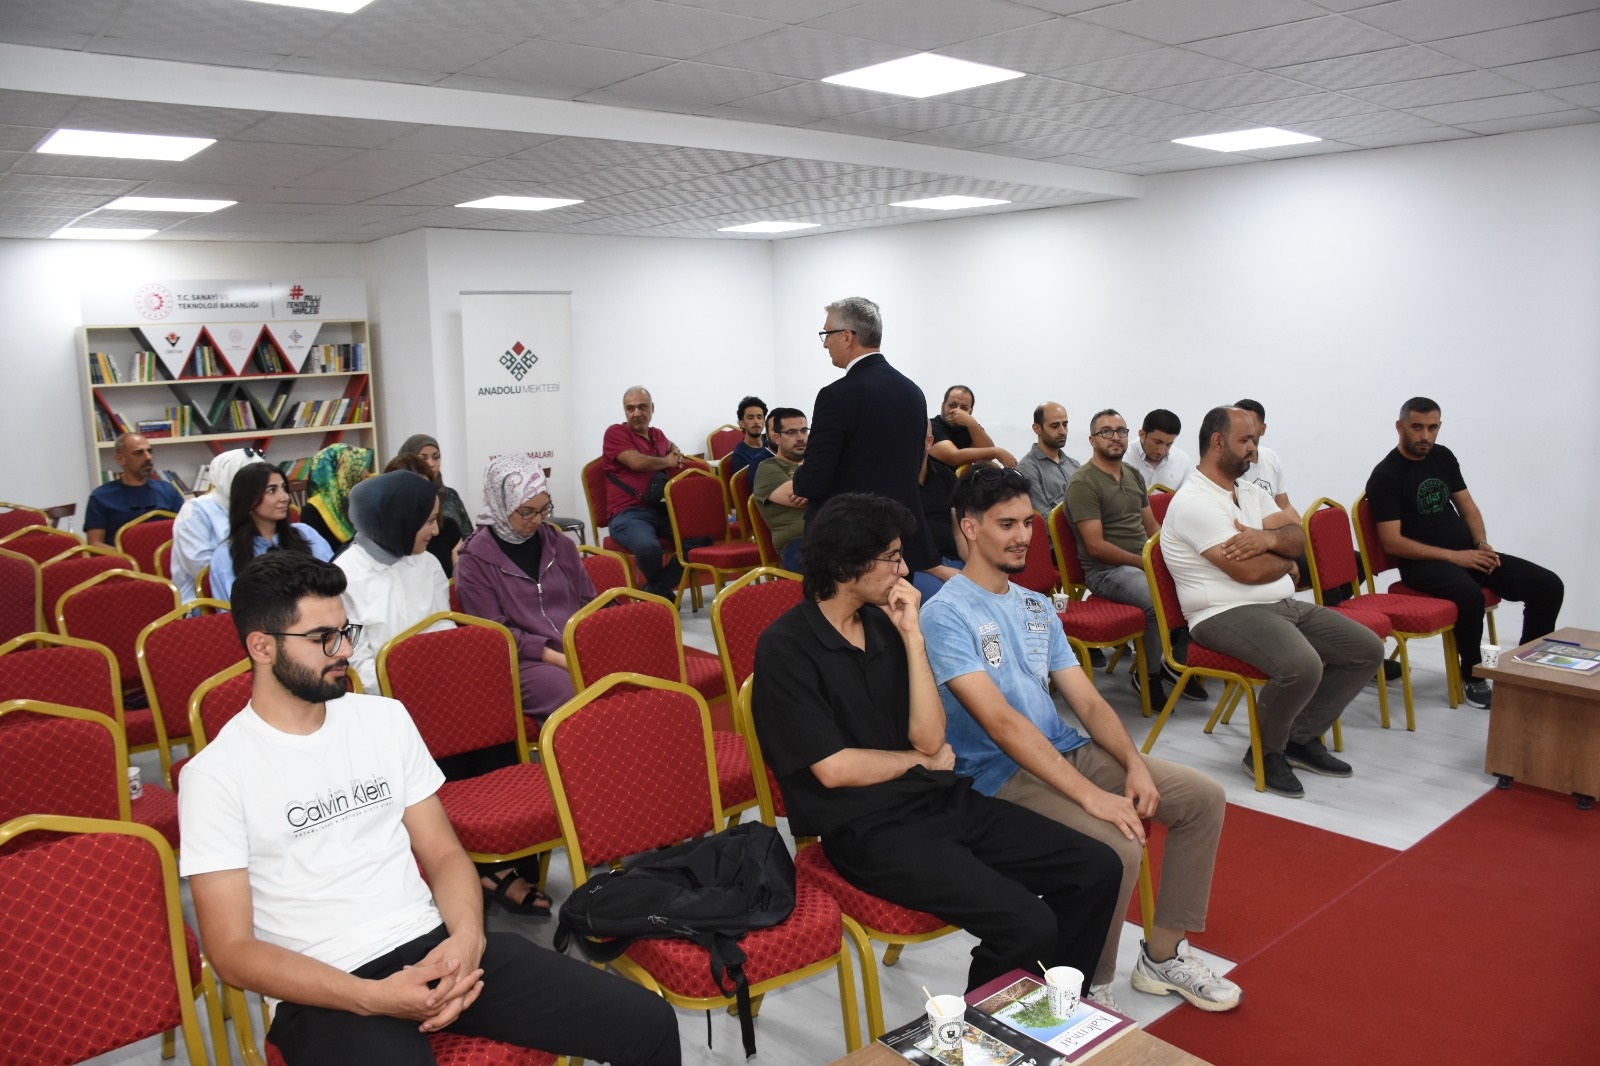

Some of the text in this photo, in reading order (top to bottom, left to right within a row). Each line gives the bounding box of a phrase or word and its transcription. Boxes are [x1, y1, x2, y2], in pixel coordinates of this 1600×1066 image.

[191, 292, 218, 301] SANAYİ
[178, 300, 258, 309] TEKNOLOJİ BAKANLIĞI
[478, 383, 560, 395] ANADOLU MEKTEBİ
[285, 776, 392, 828] Calvin Klein
